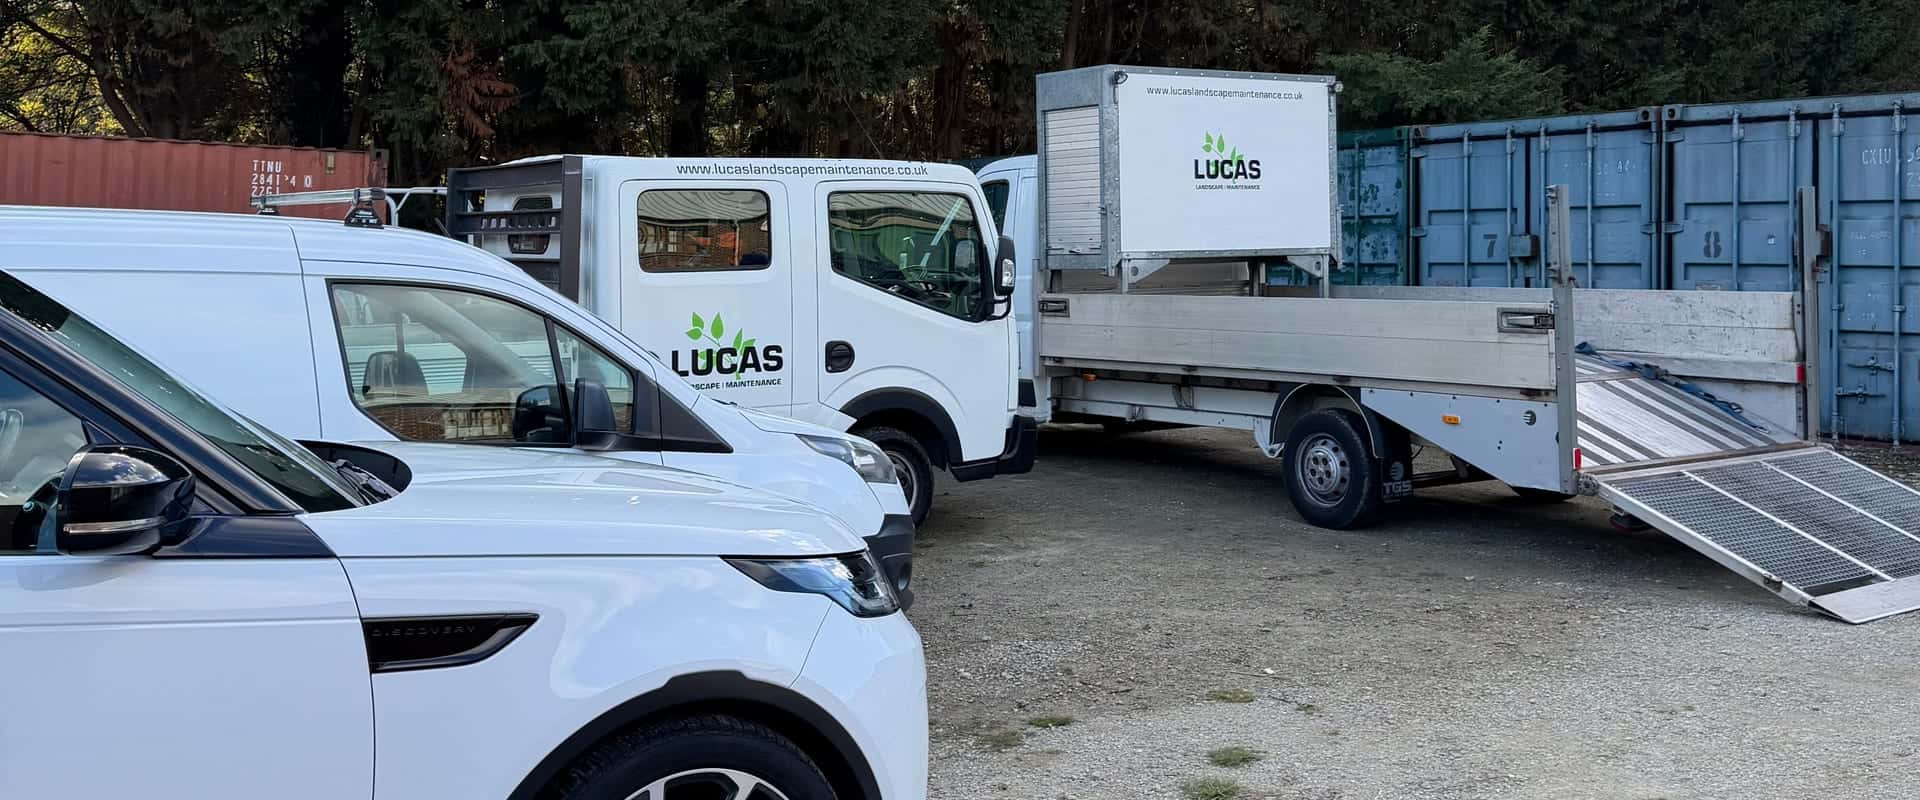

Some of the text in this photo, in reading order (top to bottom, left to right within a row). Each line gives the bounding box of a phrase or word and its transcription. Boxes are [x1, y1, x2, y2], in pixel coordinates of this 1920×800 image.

[1147, 86, 1303, 100] www.lucaslandscapemaintenance.co.uk
[253, 160, 281, 172] TTNU
[677, 163, 928, 178] www.lucaslandscapemaintenance.co.uk
[1194, 159, 1262, 179] LUCAS
[1483, 233, 1498, 258] 7
[1703, 230, 1722, 258] 8
[671, 344, 784, 377] LUCAS
[725, 378, 782, 389] MAINTENANCE
[1383, 480, 1412, 495] TGS
